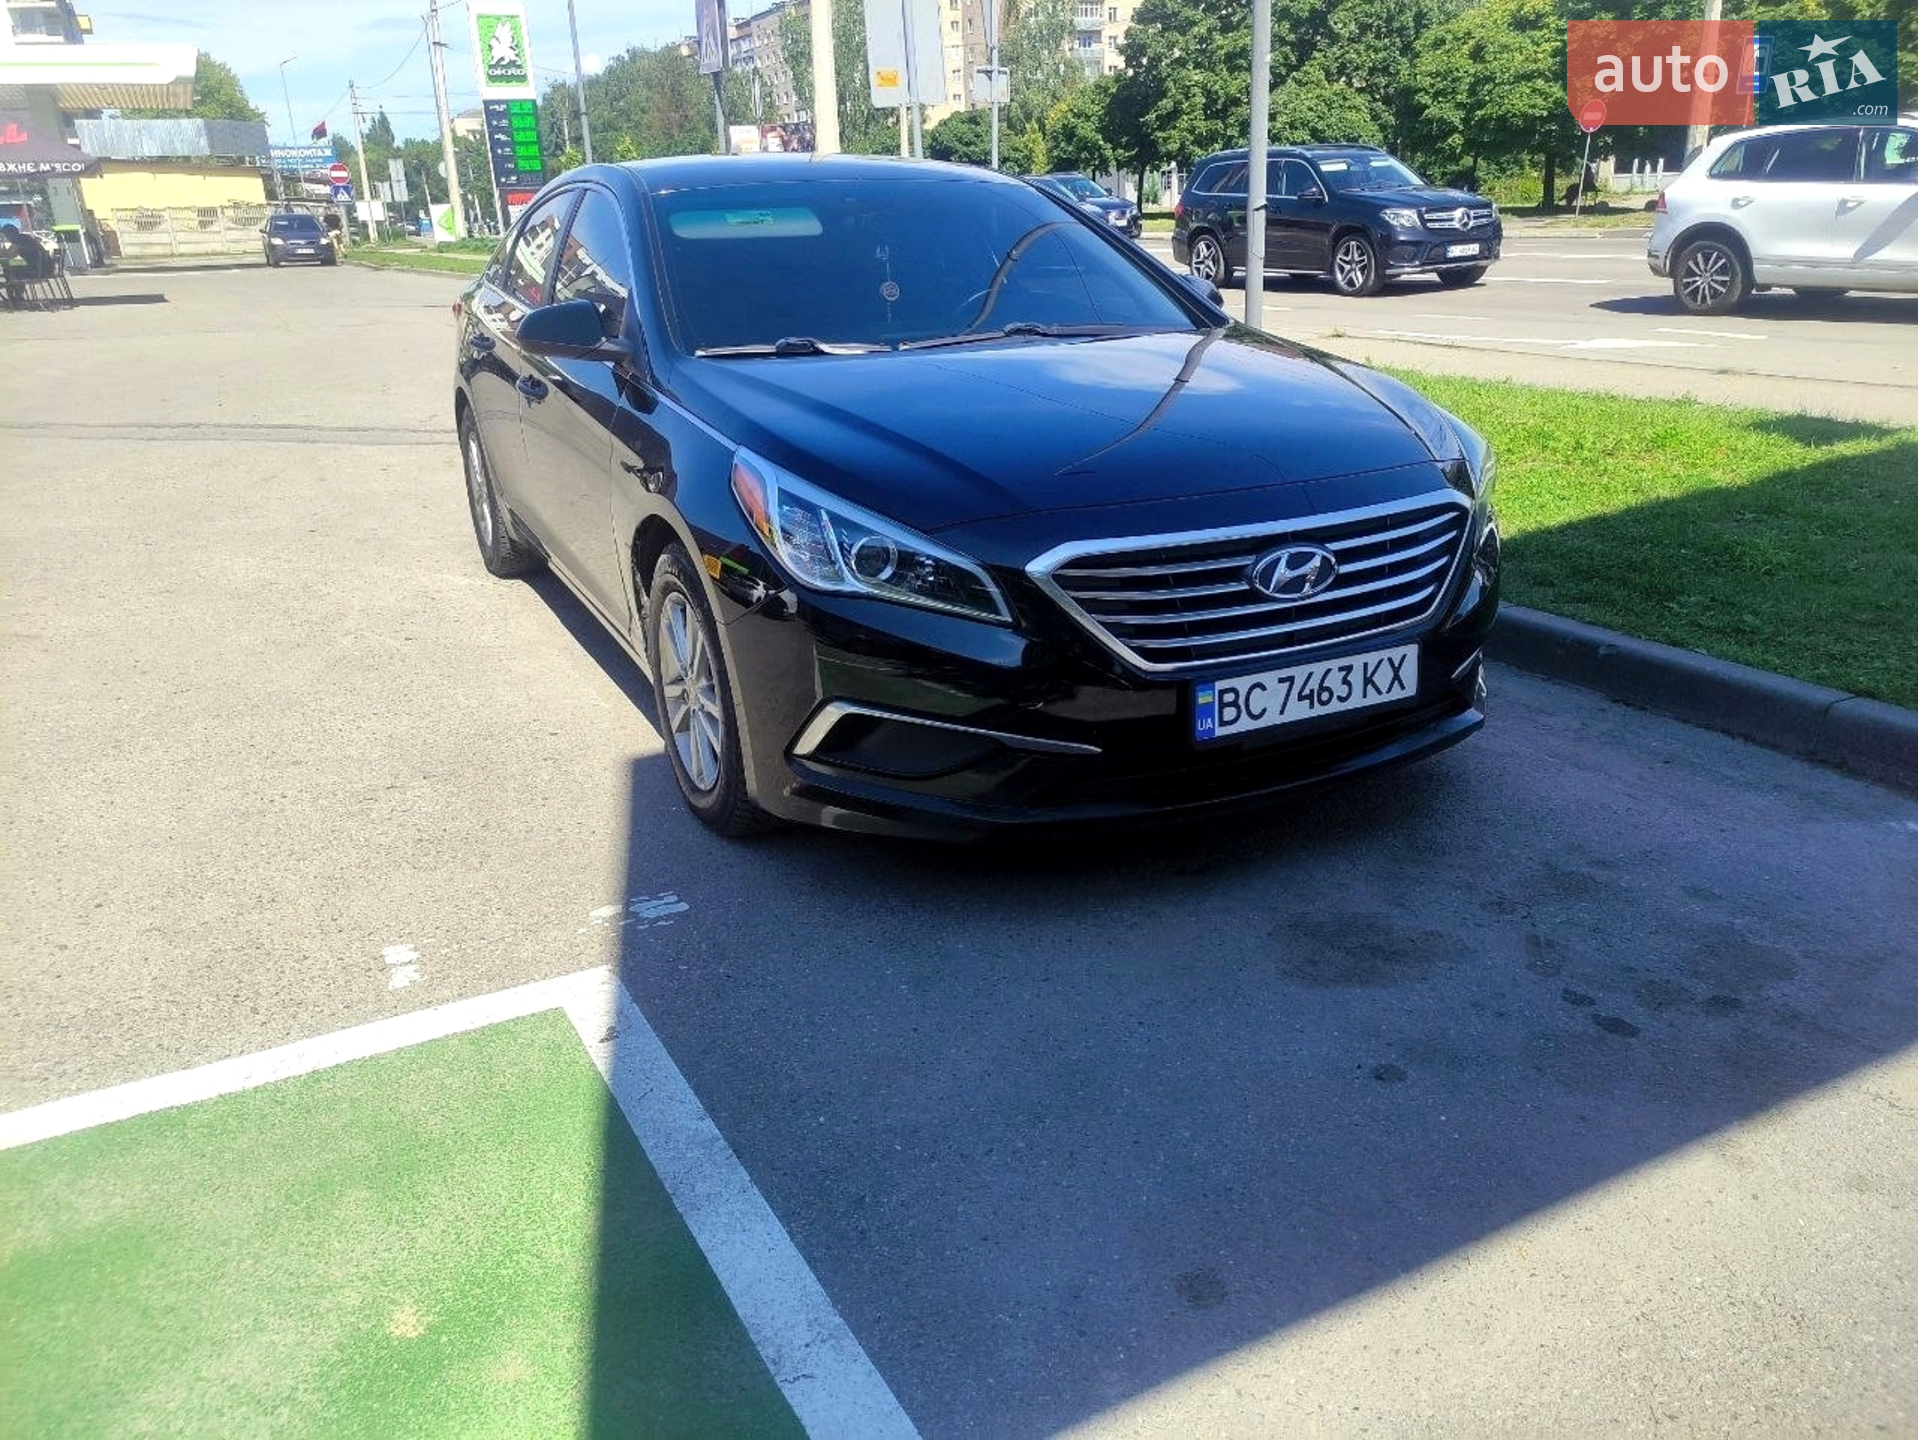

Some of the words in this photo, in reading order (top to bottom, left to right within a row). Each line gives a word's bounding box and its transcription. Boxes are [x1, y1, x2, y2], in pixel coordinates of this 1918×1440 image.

[1218, 681, 1267, 727] BC
[1277, 664, 1354, 716] 7463
[1362, 653, 1408, 699] KX
[1198, 718, 1214, 731] UA
